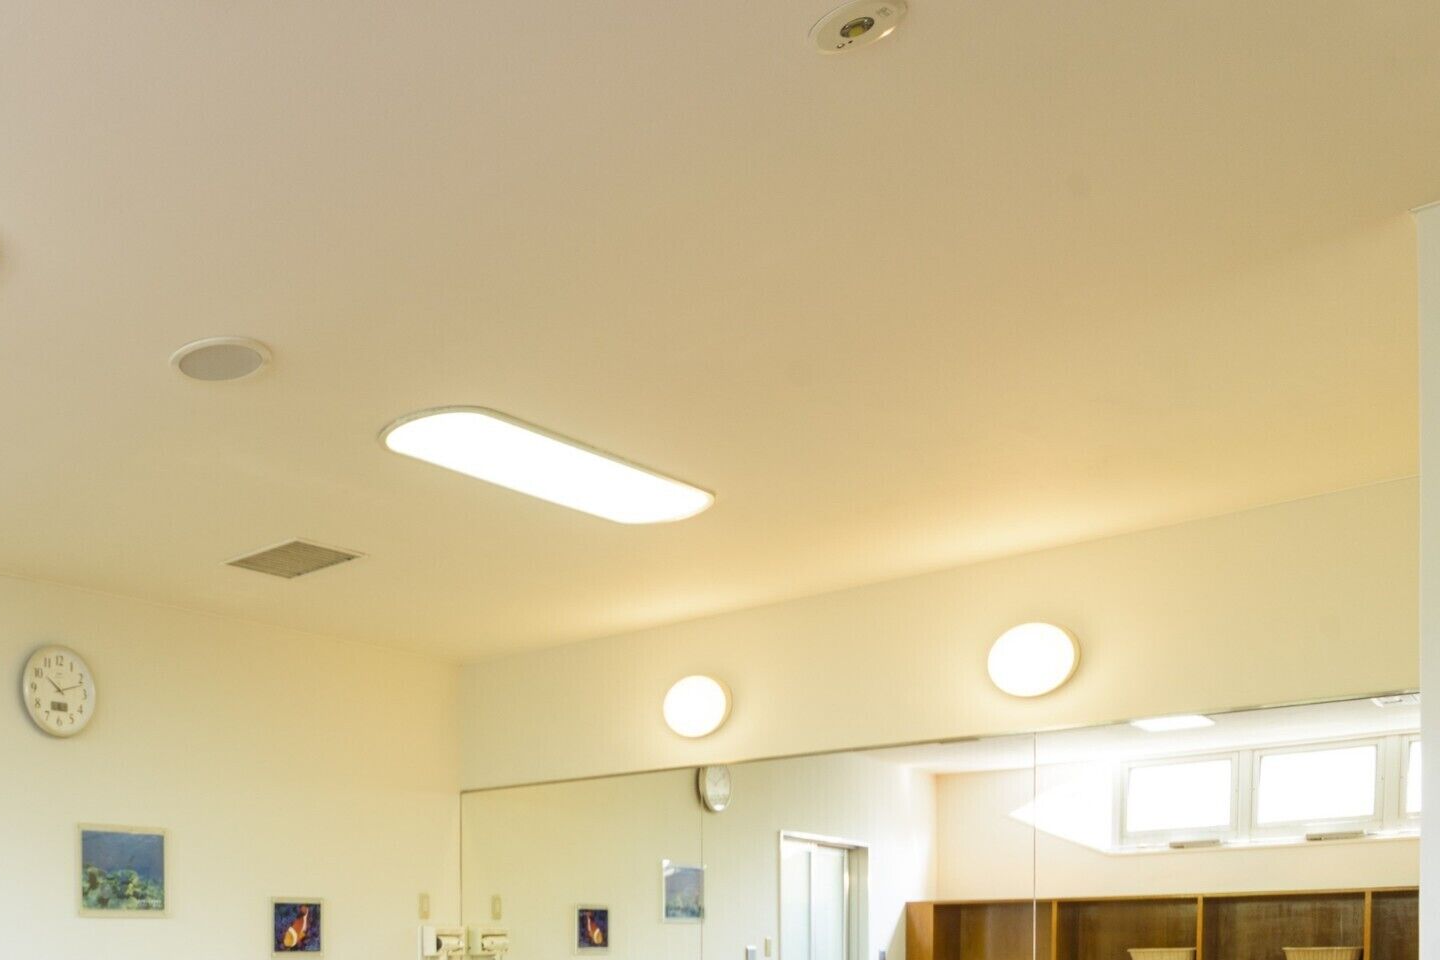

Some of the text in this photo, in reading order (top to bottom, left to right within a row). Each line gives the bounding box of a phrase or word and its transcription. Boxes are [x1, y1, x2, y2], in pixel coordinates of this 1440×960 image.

[43, 657, 52, 669] 11
[55, 655, 64, 667] 12
[34, 667, 43, 678] 10
[78, 673, 84, 685] 2
[30, 682, 37, 693] 9
[82, 689, 88, 700] 3
[34, 698, 41, 709] 8
[77, 704, 83, 714] 4
[44, 710, 50, 721] 7
[69, 713, 75, 724] 5
[56, 717, 63, 727] 6
